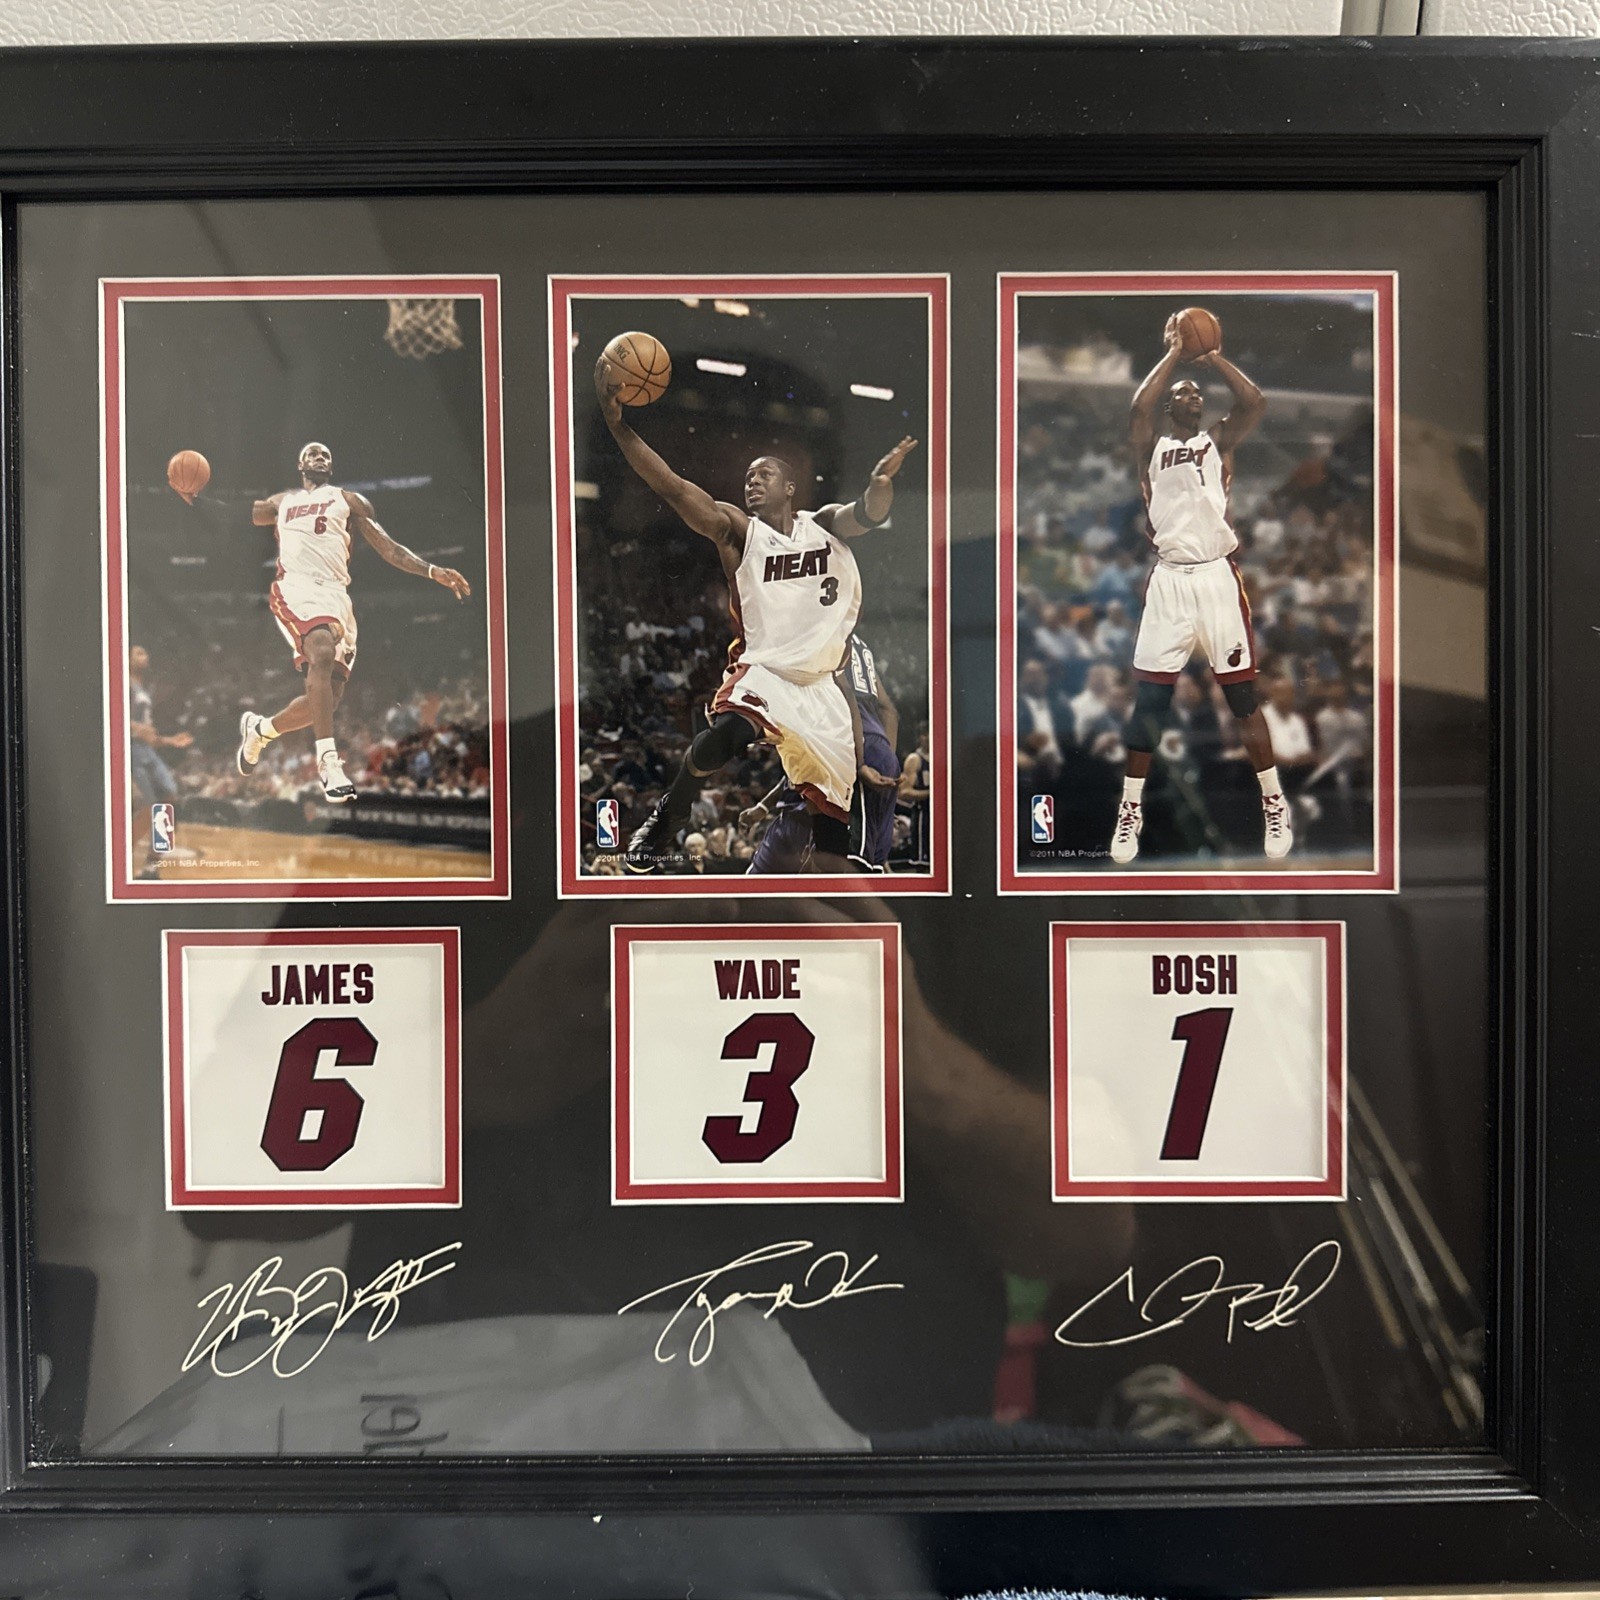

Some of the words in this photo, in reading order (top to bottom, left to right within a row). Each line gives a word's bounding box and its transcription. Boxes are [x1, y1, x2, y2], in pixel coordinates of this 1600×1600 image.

[285, 499, 336, 523] HEAT
[314, 516, 328, 535] 6
[763, 541, 832, 583] HEAT
[819, 576, 839, 607] 3
[851, 647, 878, 698] 22
[179, 860, 198, 868] NBA
[643, 854, 686, 862] Properties
[261, 963, 374, 1006] JAMES
[714, 959, 801, 1000] WADE
[1152, 955, 1237, 995] BOSH
[260, 1017, 379, 1172] 6
[702, 1012, 815, 1164] 3
[1159, 1007, 1234, 1160] 1
